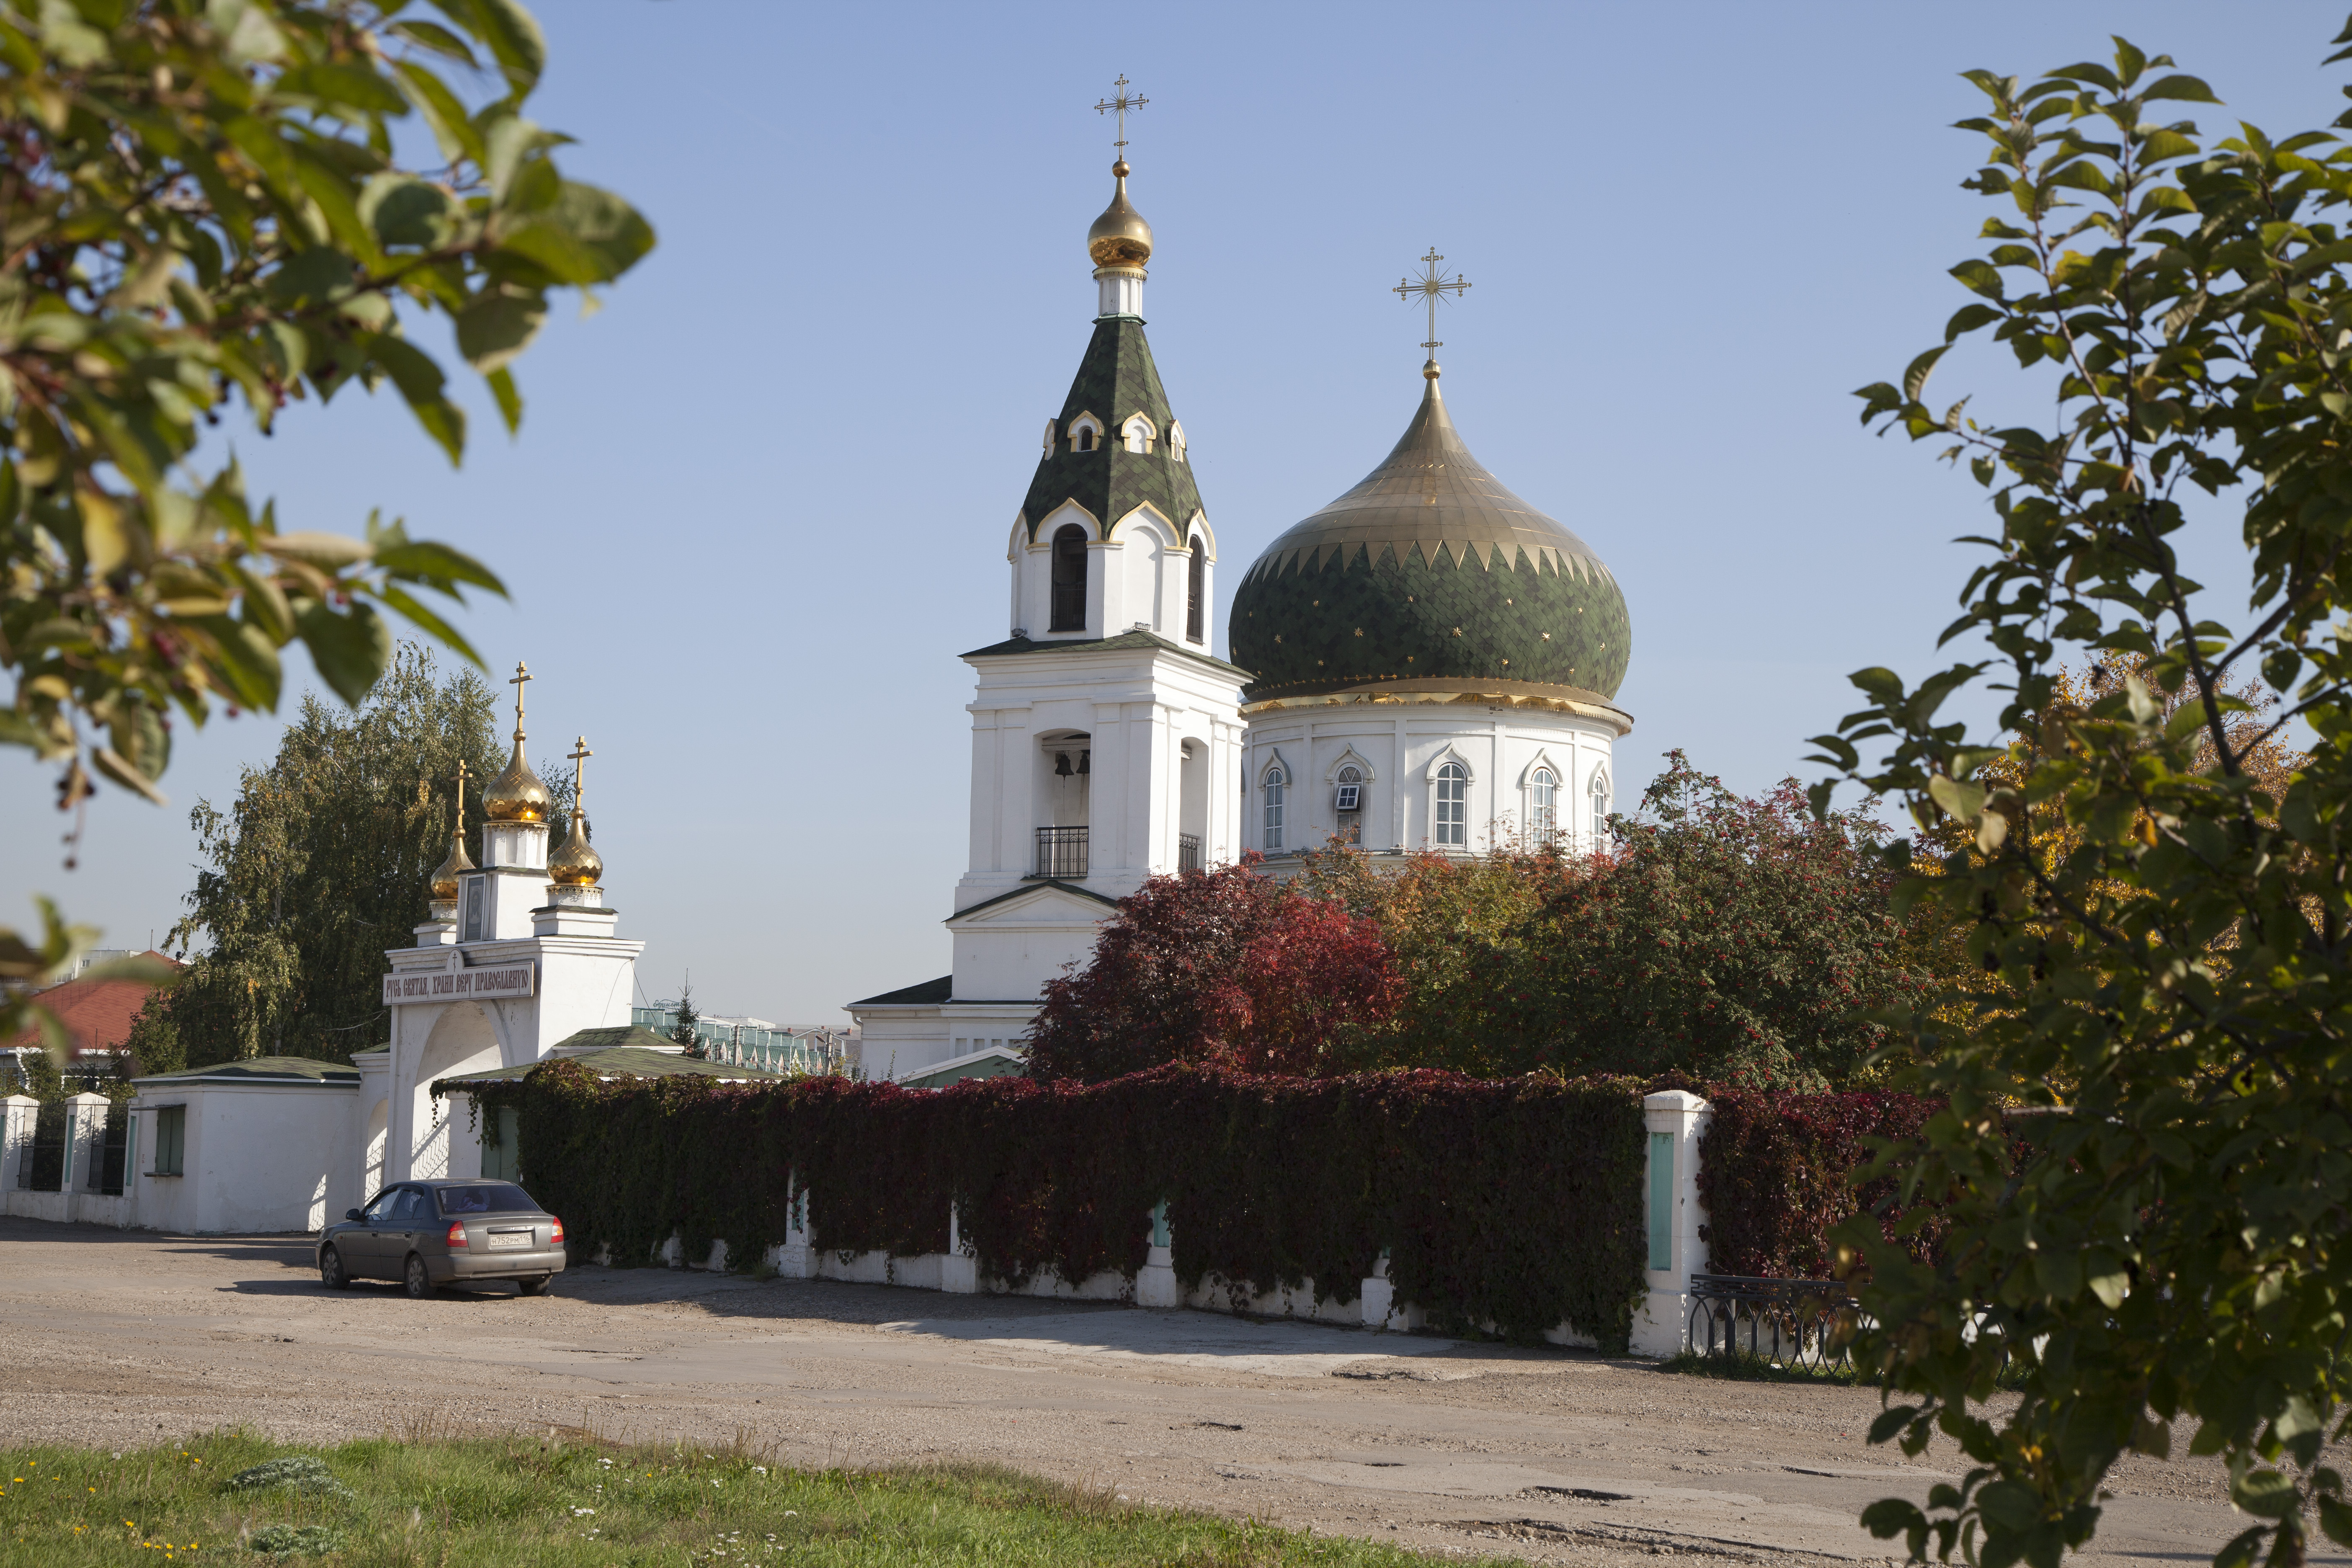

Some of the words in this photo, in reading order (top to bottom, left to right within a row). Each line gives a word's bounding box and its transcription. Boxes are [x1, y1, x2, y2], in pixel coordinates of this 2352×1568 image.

[386, 979, 401, 1003] РУСЬ
[403, 977, 429, 998] СВЯТАЯ,
[432, 975, 454, 994] ХРАНИ
[456, 973, 472, 997] ВЕРУ
[475, 969, 528, 994] ПРАВОСЛАВНУЮ
